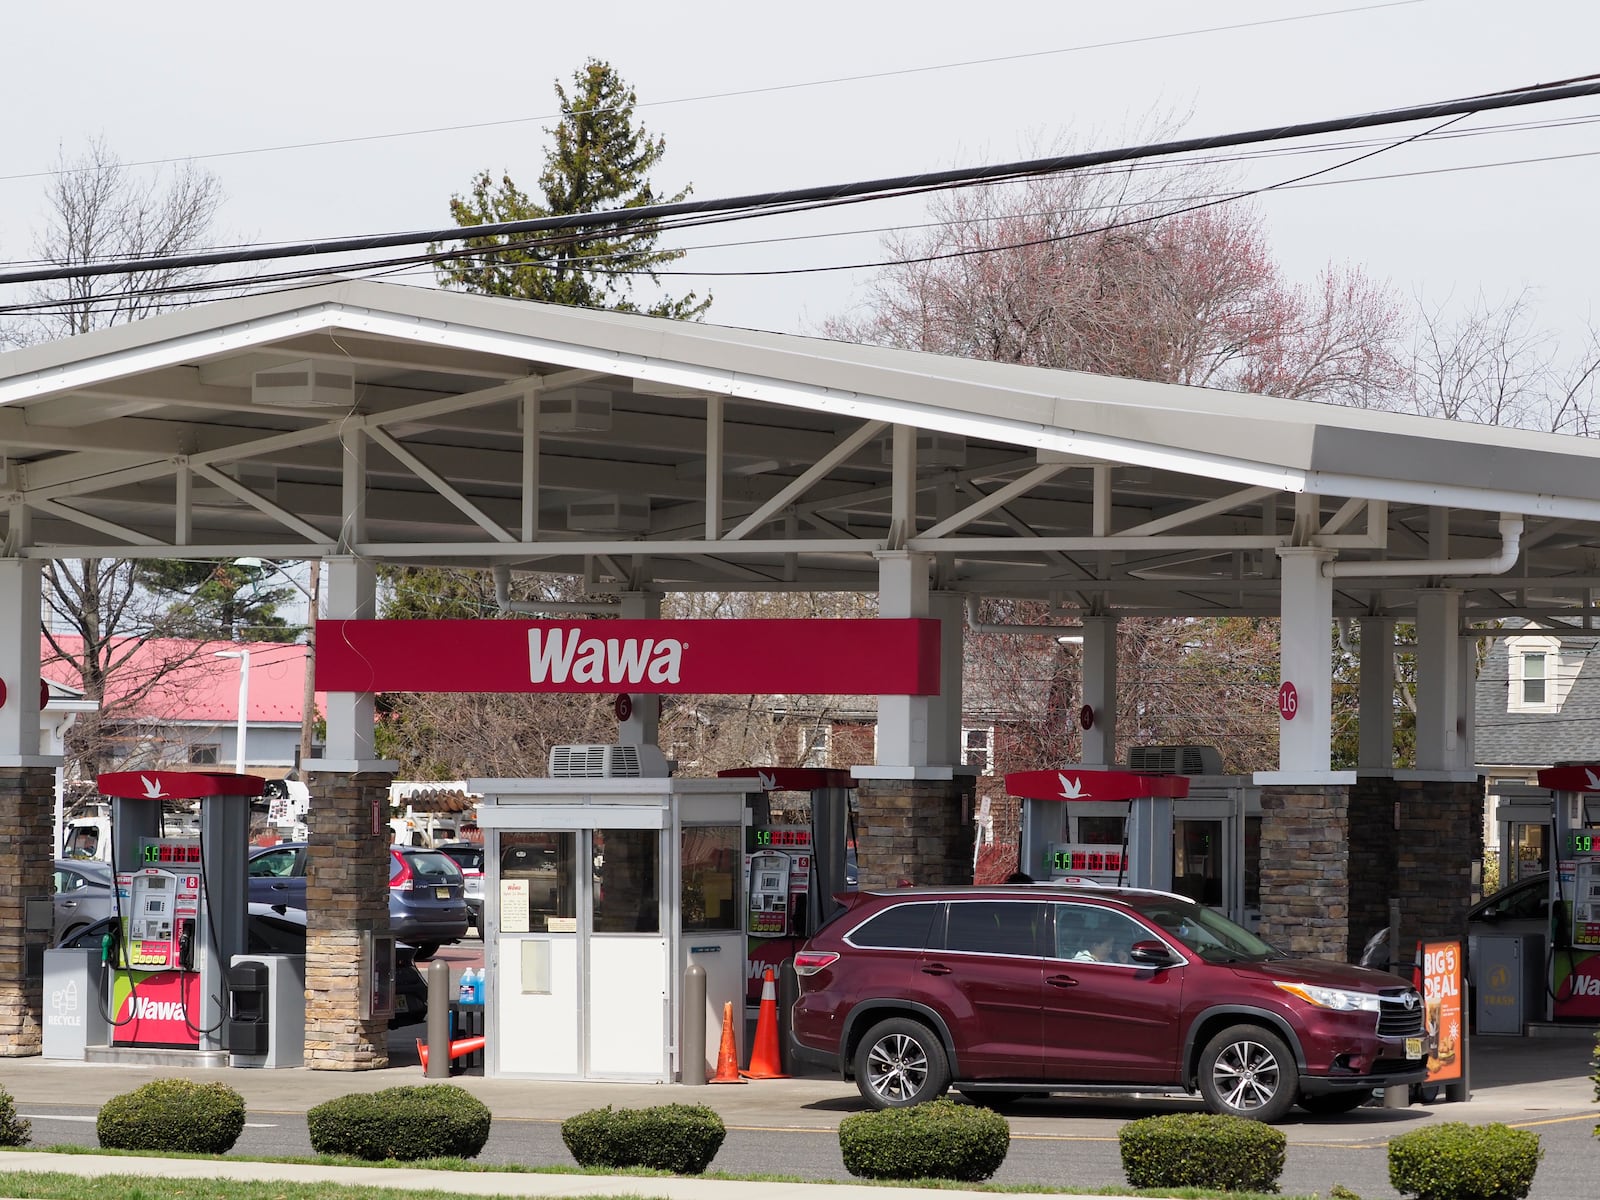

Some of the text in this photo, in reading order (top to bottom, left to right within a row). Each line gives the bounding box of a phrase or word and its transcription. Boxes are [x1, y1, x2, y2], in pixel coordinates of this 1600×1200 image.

[528, 627, 683, 684] Wawa
[620, 699, 628, 715] 6
[1282, 690, 1296, 712] 16
[189, 877, 195, 887] 8
[1424, 951, 1445, 977] BIG
[1424, 973, 1458, 1002] DEAL
[127, 996, 186, 1021] Wawa
[48, 1015, 81, 1026] RECYCLE
